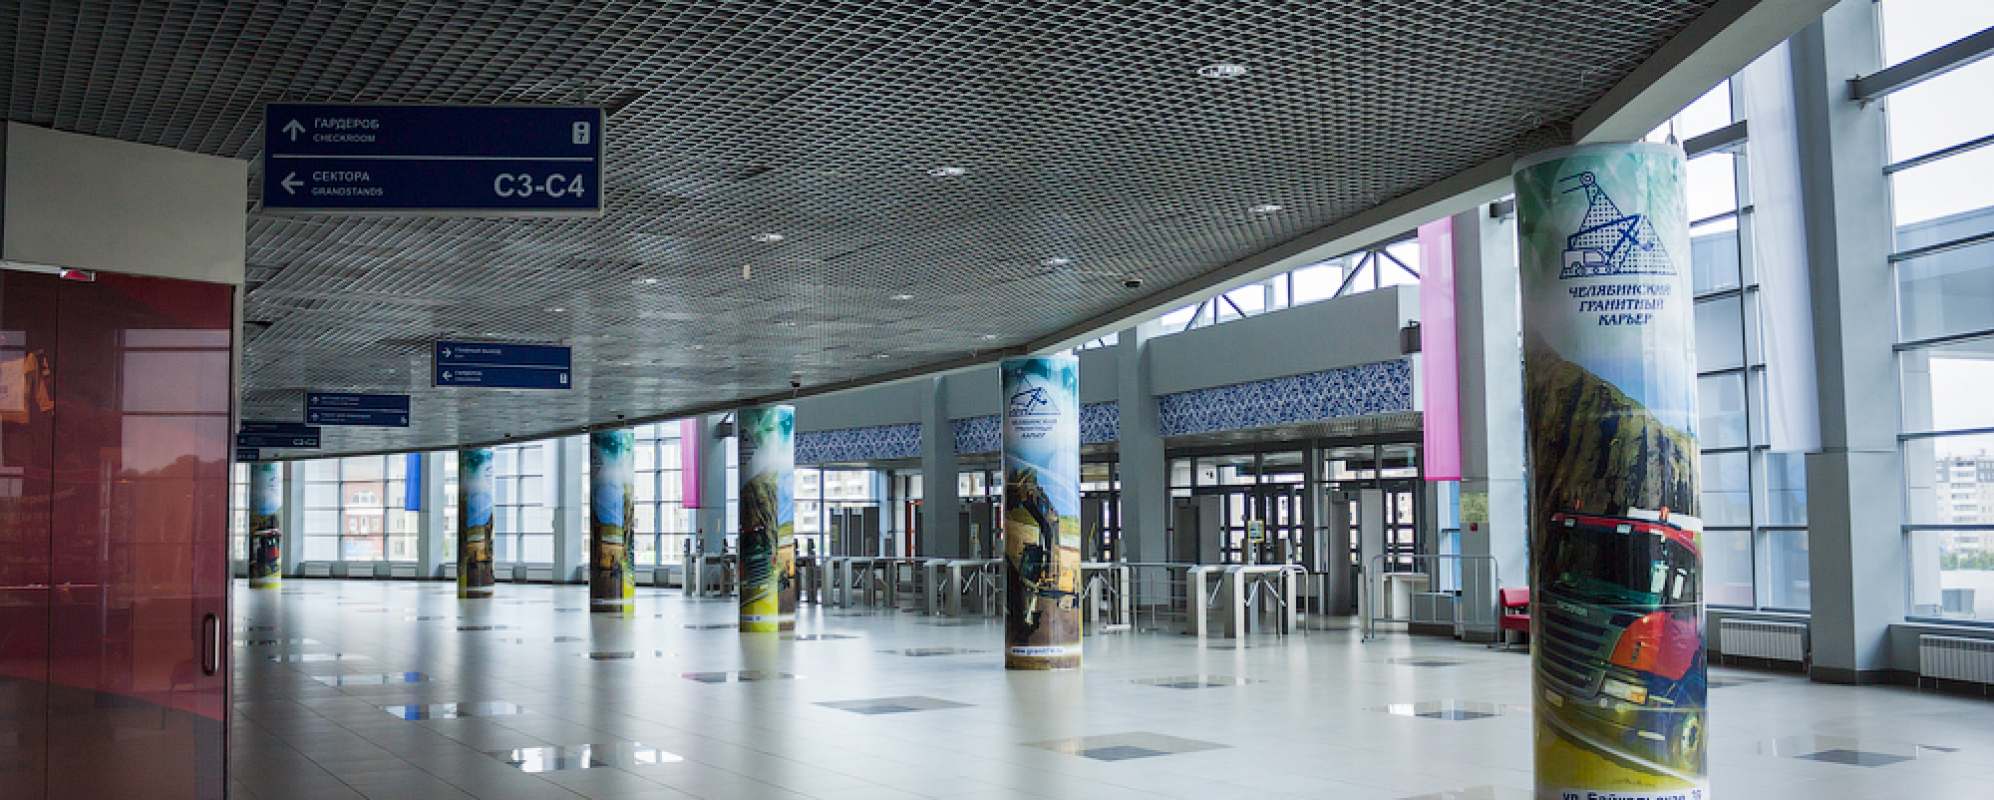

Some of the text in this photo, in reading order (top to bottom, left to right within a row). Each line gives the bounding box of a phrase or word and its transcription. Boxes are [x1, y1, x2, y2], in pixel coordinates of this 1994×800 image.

[314, 117, 380, 130] ГАРДЕРОБ
[313, 133, 376, 143] CHECKROOM
[312, 170, 370, 182] СЕКТОРА
[311, 186, 384, 197] GRANDSTANDS
[1578, 298, 1664, 312] ГРАНИТНЫЙ
[1598, 313, 1653, 326] КАРЬЕР
